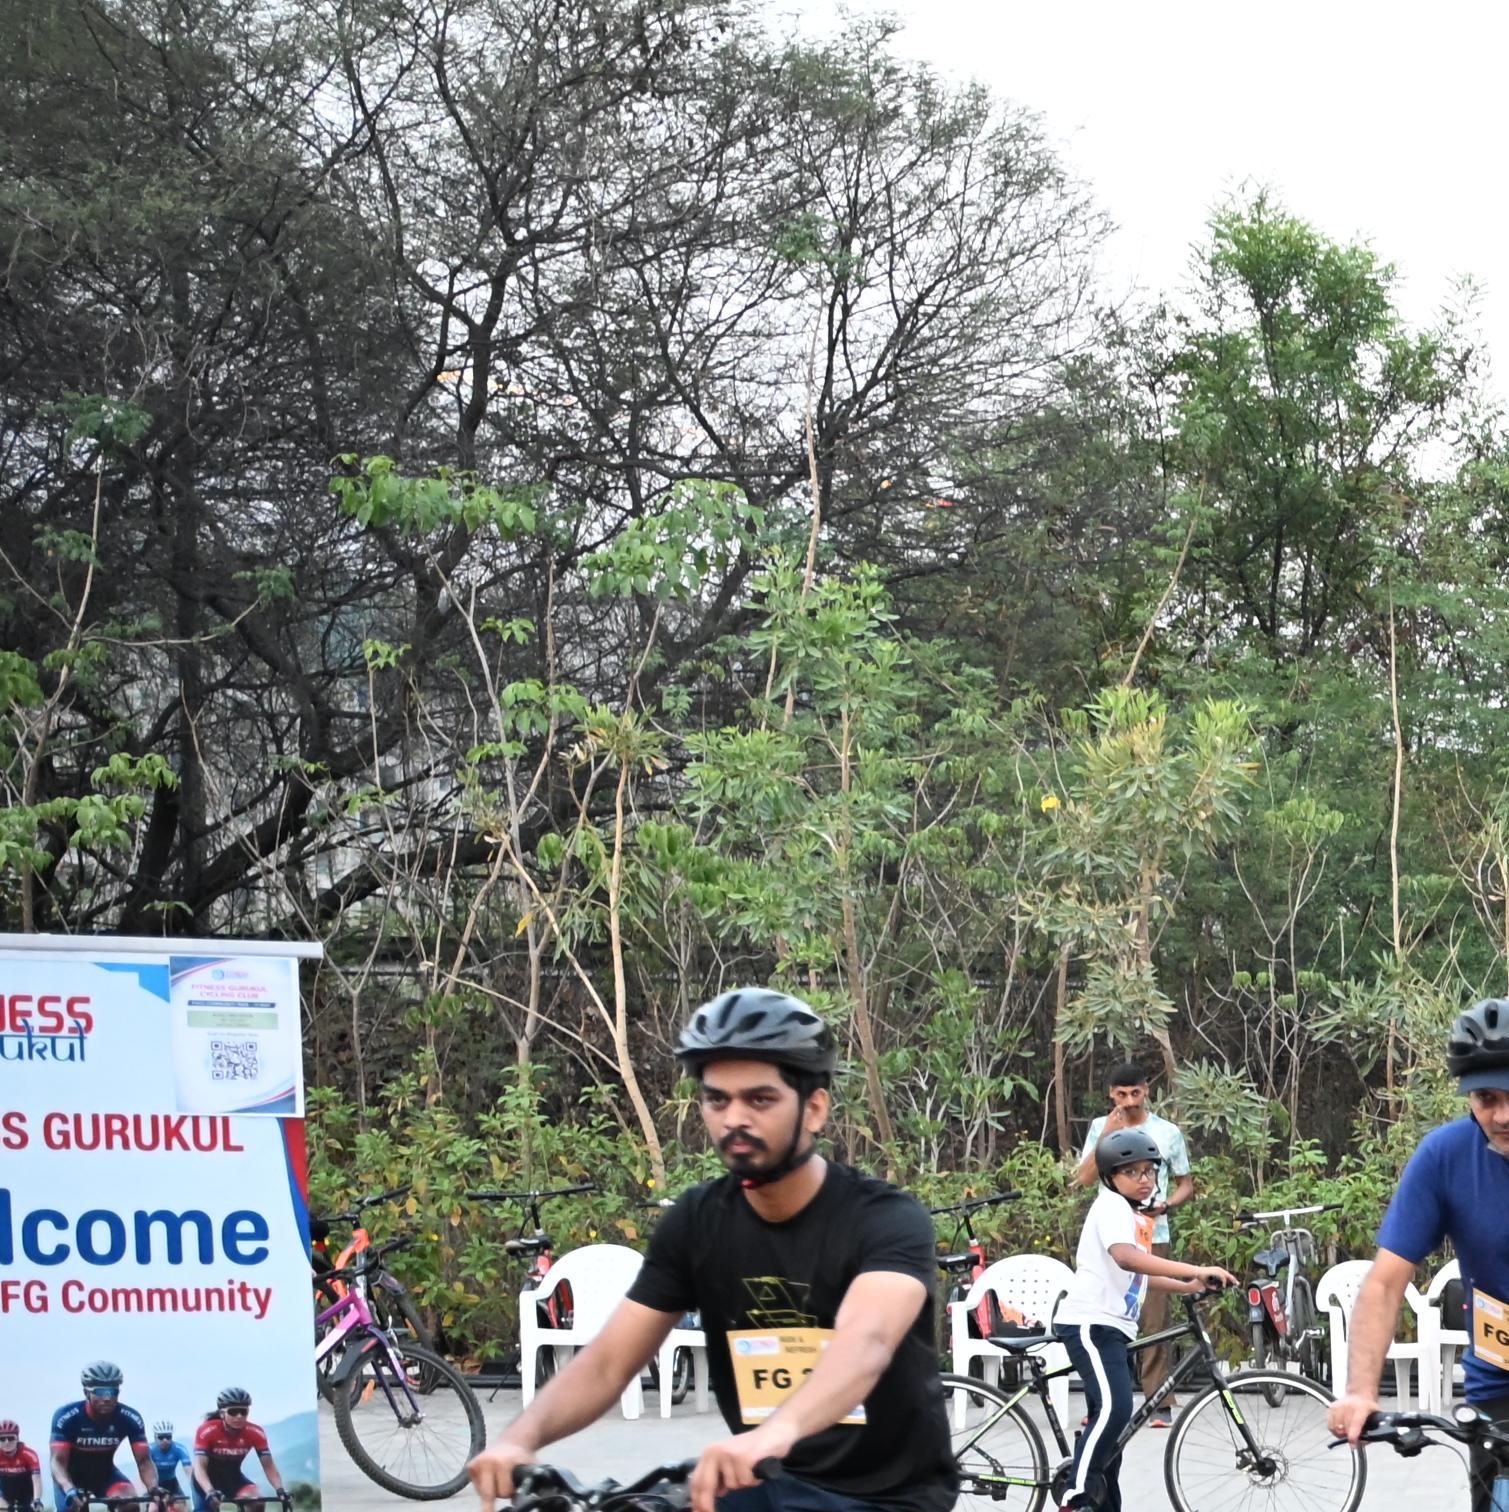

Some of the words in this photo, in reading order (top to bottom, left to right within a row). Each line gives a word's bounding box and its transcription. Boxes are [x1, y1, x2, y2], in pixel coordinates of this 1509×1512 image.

[43, 1112, 244, 1152] GURUKUL
[1, 1280, 48, 1313] FG
[62, 1279, 272, 1320] Community
[752, 1368, 792, 1389] FG
[76, 1437, 120, 1446] FITNESS
